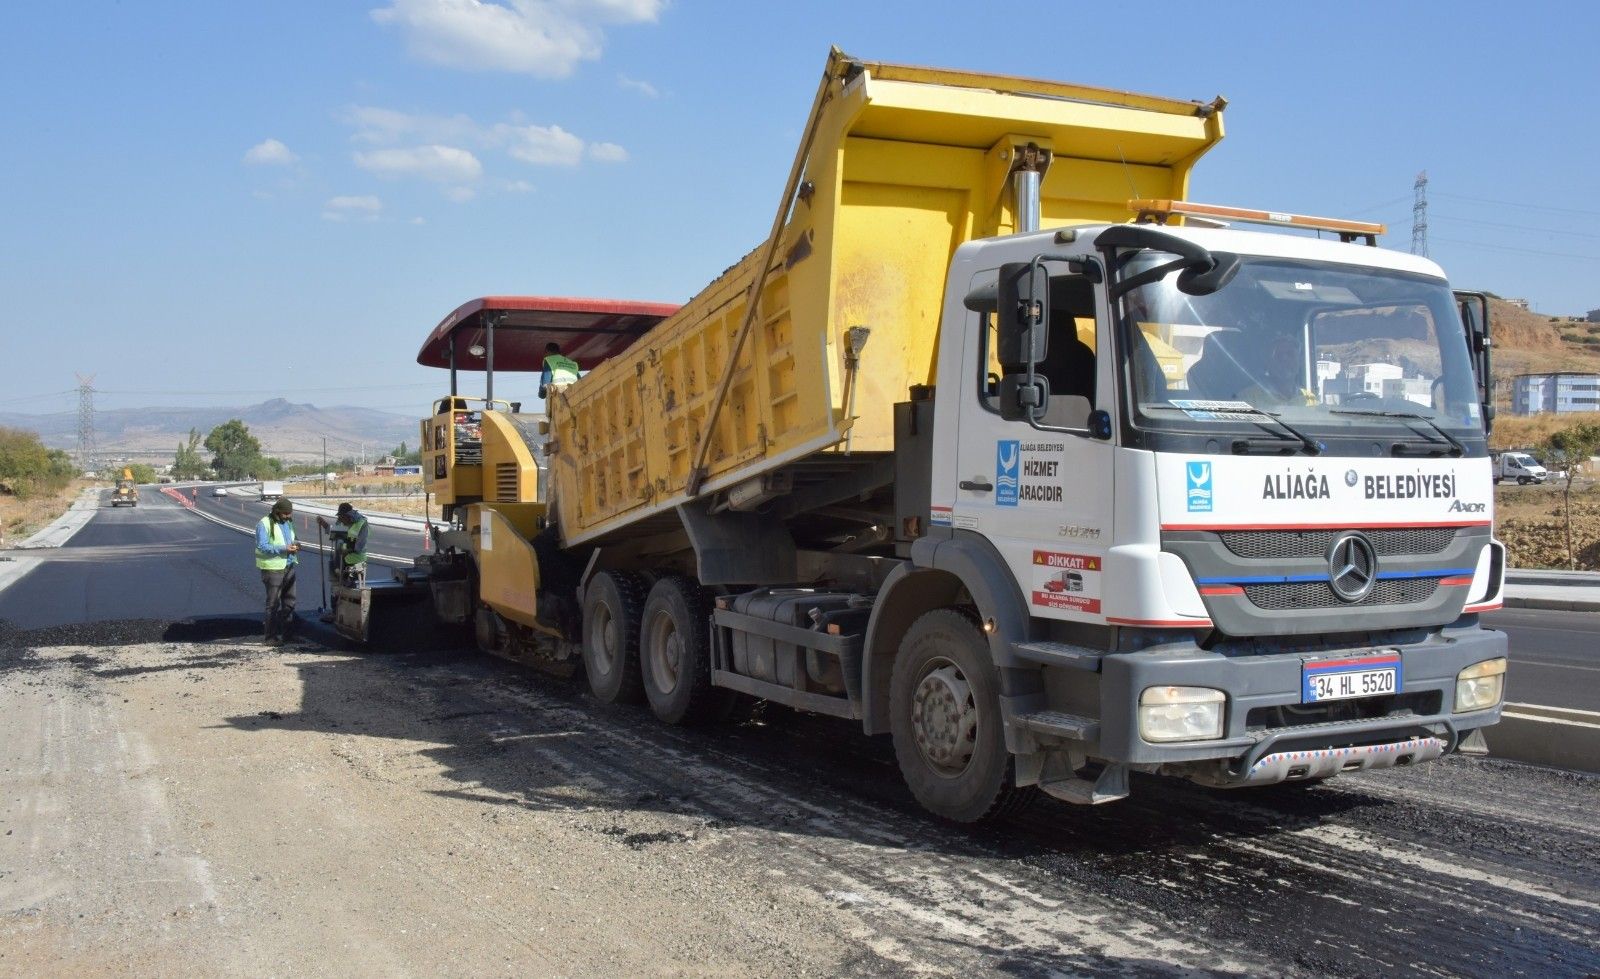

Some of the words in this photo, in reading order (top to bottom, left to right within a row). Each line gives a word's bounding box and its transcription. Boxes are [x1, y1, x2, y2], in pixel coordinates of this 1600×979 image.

[1024, 456, 1059, 477] HİZMET
[1019, 484, 1063, 502] ARACIDIR
[1262, 467, 1331, 500] ALİAĞA
[1364, 467, 1457, 499] BELEDİYESİ
[1048, 553, 1084, 569] DİKKAT!
[1318, 678, 1334, 698] 34
[1340, 676, 1355, 695] HL
[1363, 672, 1393, 693] 5520
